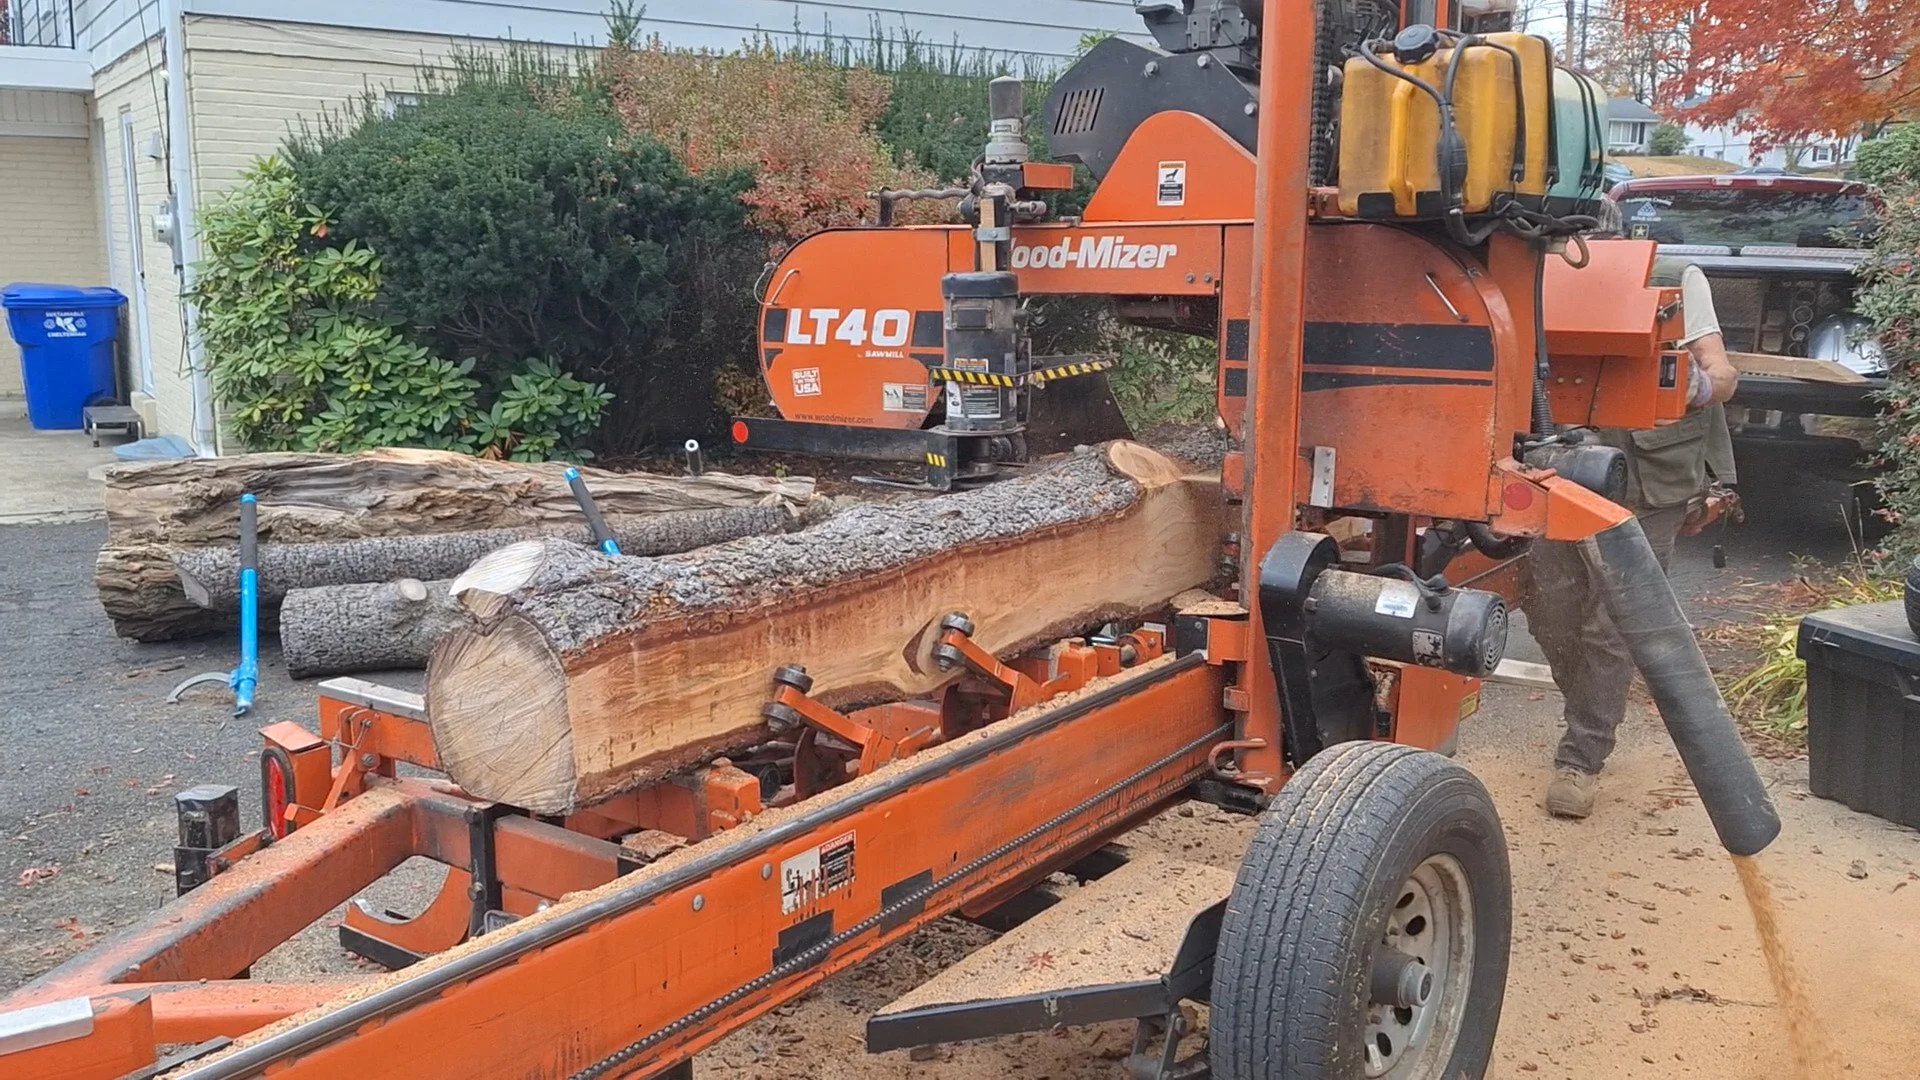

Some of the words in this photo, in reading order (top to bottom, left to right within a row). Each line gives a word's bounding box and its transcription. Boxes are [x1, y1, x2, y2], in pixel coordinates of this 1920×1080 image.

[1010, 236, 1177, 269] ood-Mizer
[787, 308, 910, 346] LT40
[865, 350, 903, 358] SAWMILL
[794, 370, 817, 379] BUILT
[796, 382, 819, 394] USA
[795, 413, 875, 424] www.woodmizer.com
